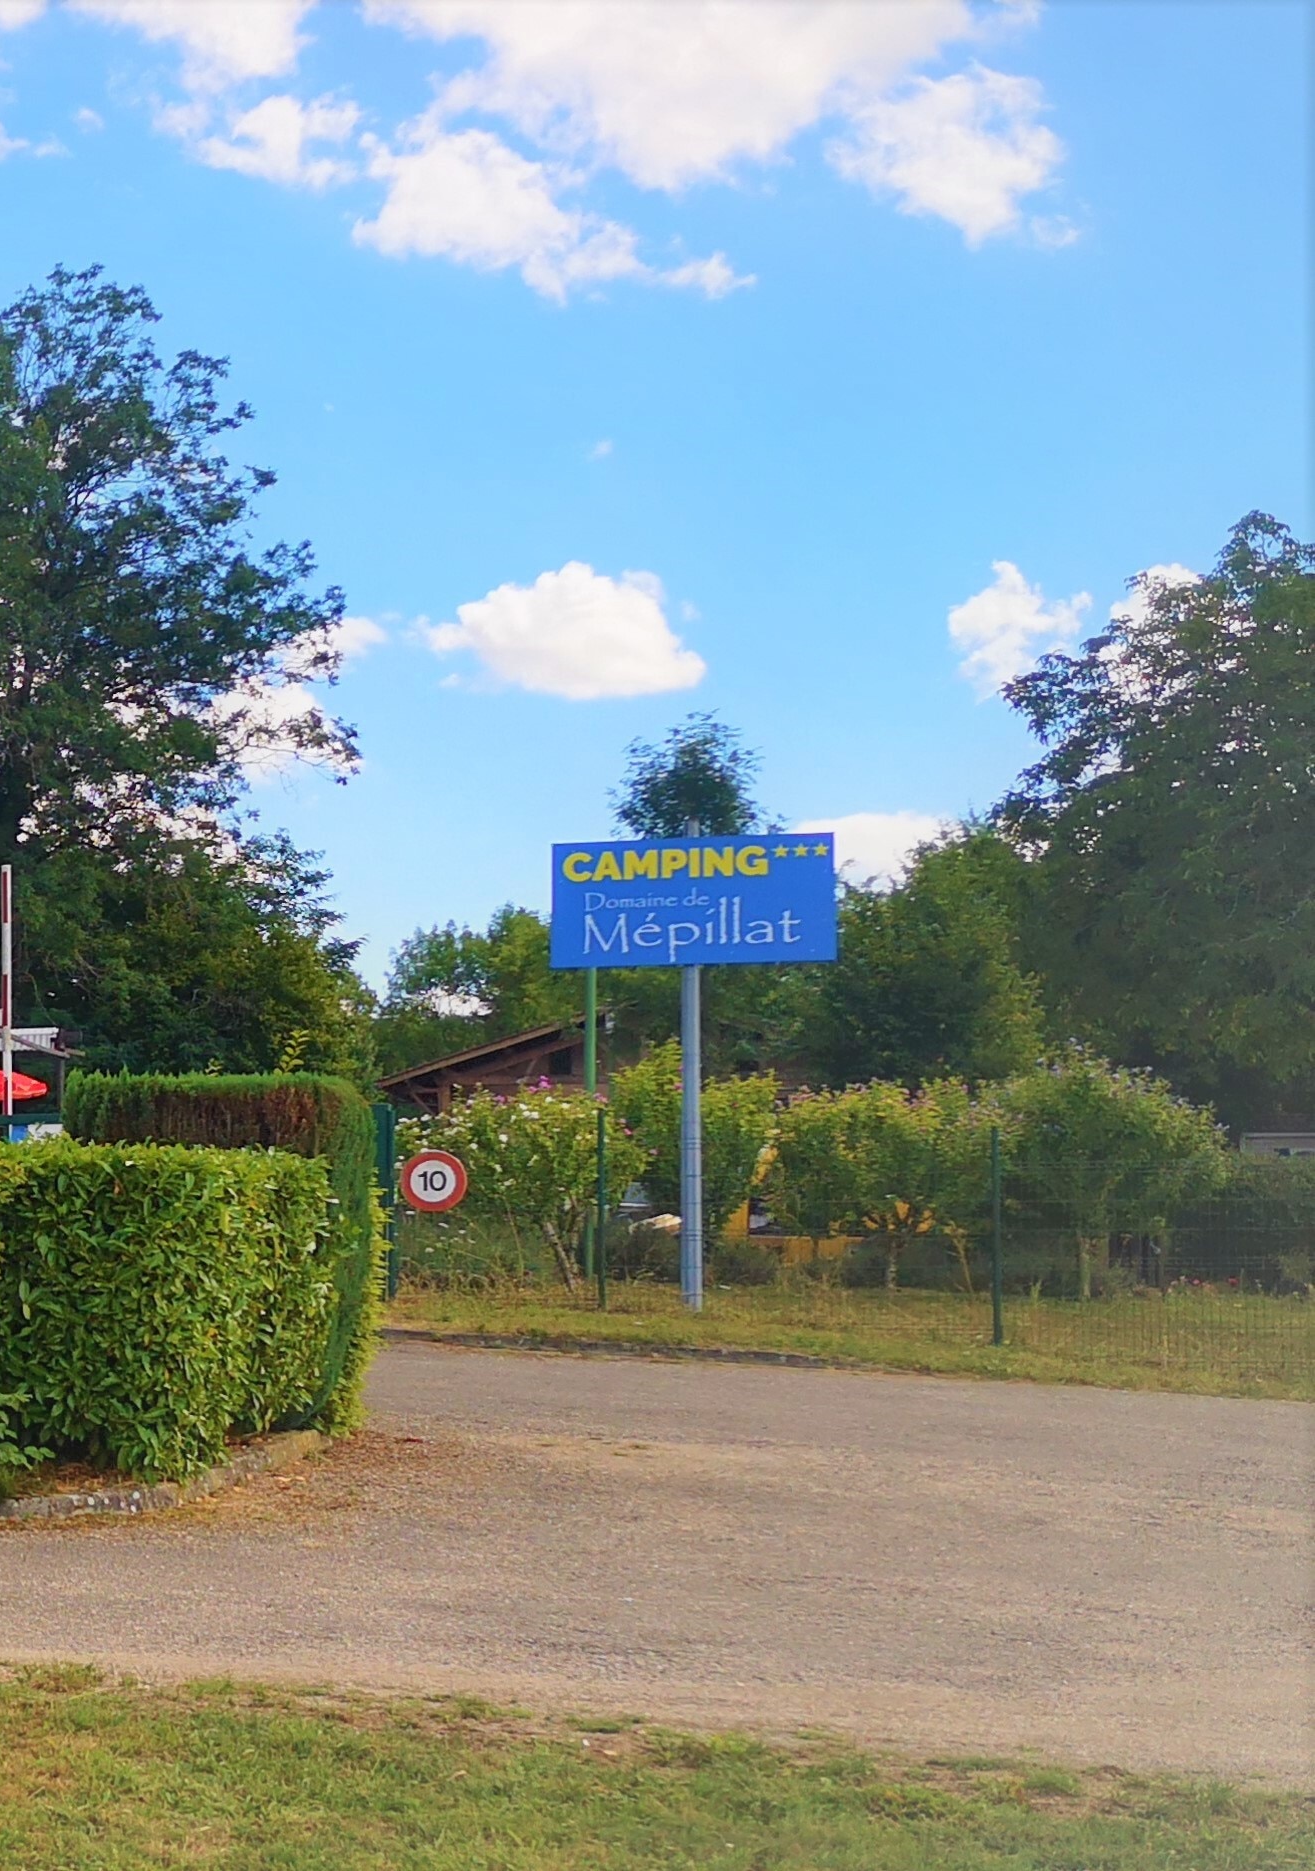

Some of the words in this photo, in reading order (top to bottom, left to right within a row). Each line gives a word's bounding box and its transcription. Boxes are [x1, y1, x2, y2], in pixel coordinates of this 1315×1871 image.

[562, 845, 770, 883] CAMPING
[584, 892, 678, 912] Domaine
[683, 887, 711, 907] de
[582, 896, 802, 963] Mépillat
[417, 1170, 447, 1192] 10
